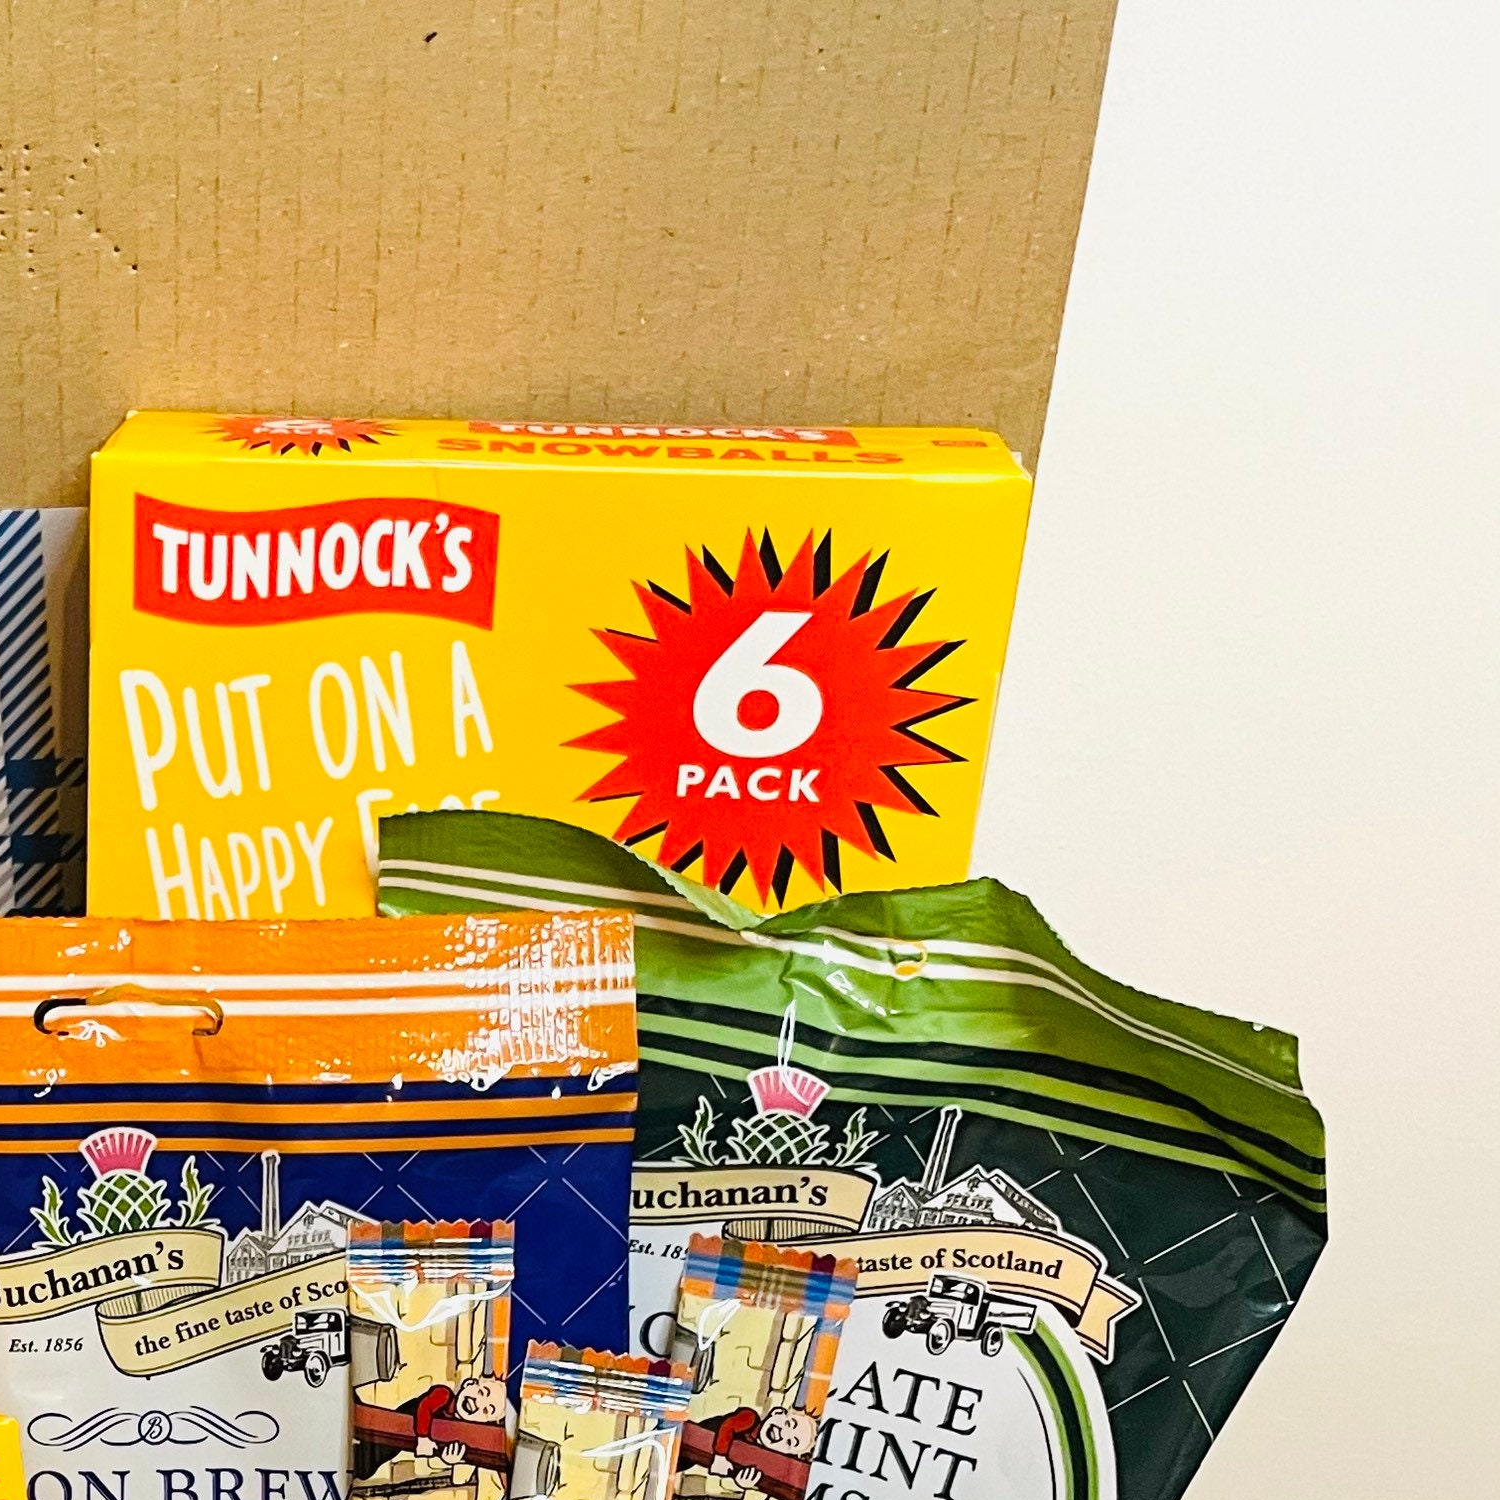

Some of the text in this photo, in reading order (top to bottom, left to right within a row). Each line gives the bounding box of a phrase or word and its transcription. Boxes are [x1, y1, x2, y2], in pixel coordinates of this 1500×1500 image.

[437, 438, 904, 464] SNOWBALLS
[500, 423, 830, 442] TUNNOCK'S
[153, 516, 473, 601] TUNNOCK'S
[692, 611, 823, 759] 6
[120, 640, 494, 811] PUT ON A
[676, 763, 821, 804] PACK
[144, 816, 333, 921] HAPPY
[632, 1176, 828, 1210] uchanan's
[628, 1238, 656, 1257] Est.
[857, 1248, 1063, 1280] taste of Scotland
[134, 1332, 171, 1357] the
[174, 1315, 222, 1349] fine
[225, 1298, 276, 1329] taste
[279, 1285, 303, 1312] of
[9, 1336, 84, 1354] Est. 1856
